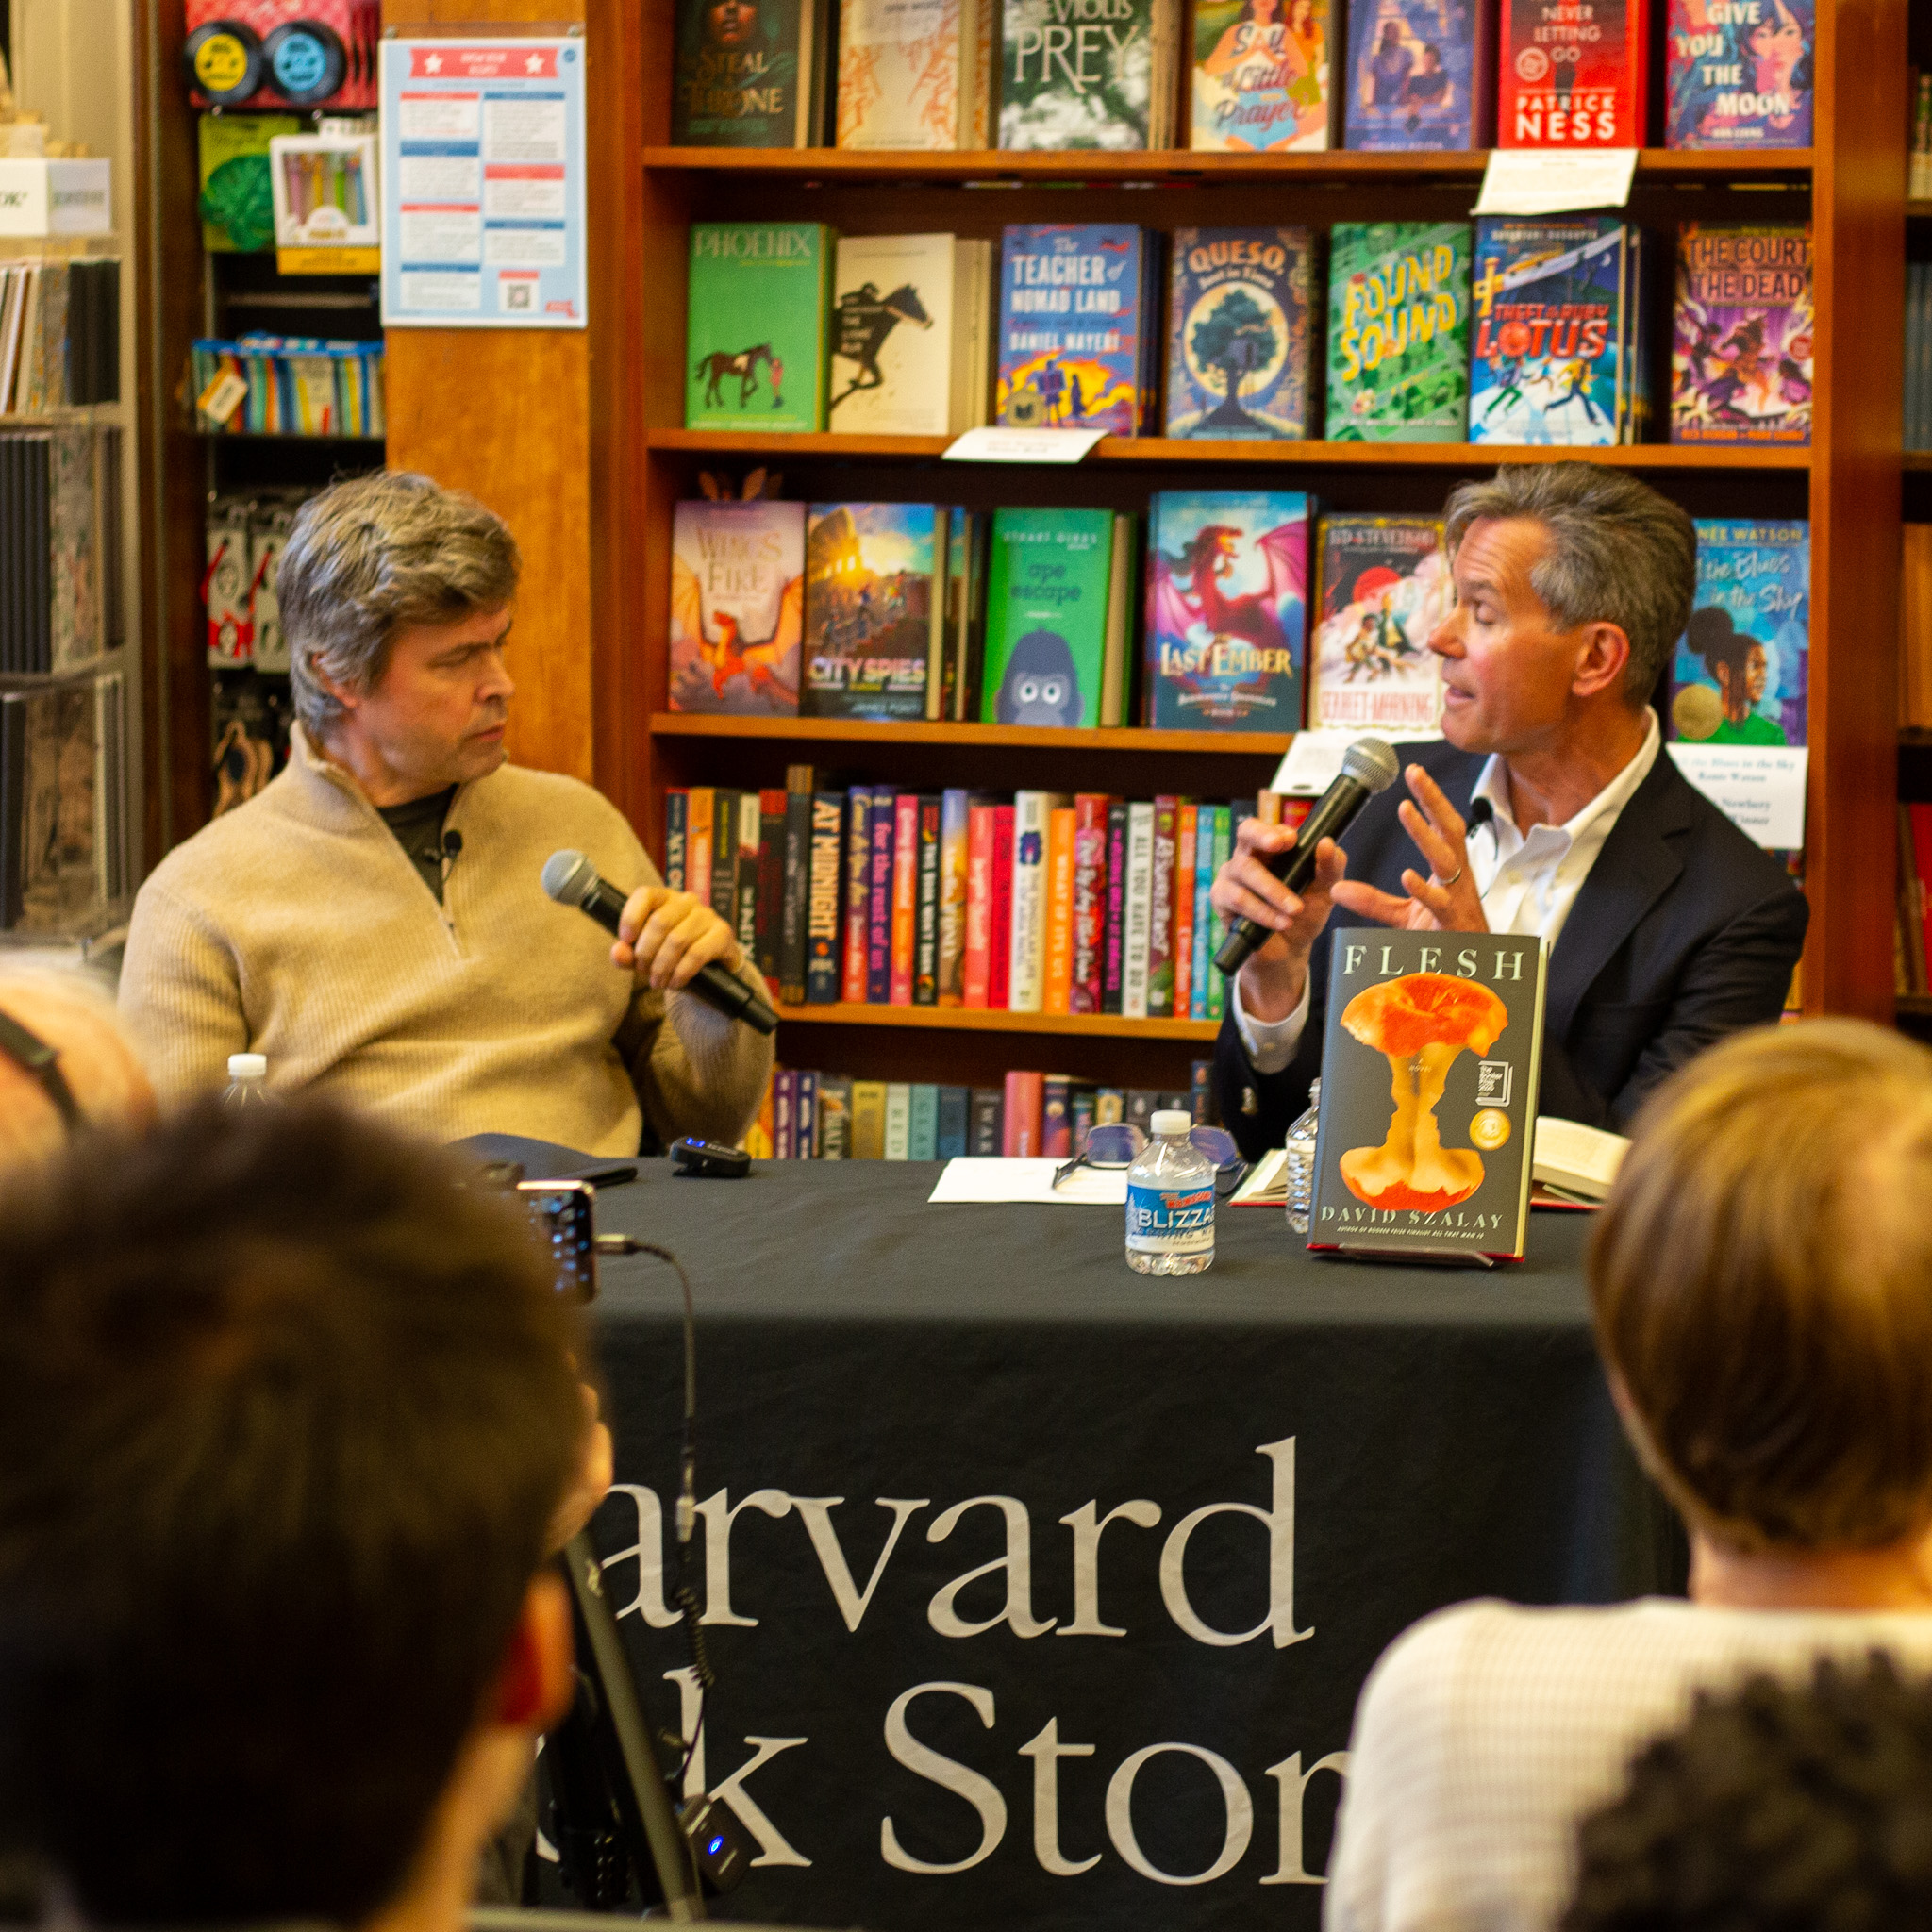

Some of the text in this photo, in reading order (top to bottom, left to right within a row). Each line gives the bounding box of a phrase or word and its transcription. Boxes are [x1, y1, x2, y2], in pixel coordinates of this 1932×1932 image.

[1542, 5, 1593, 21] NEVER
[1707, 2, 1761, 25] GIVE
[1534, 25, 1601, 43] LETTING
[1676, 34, 1724, 58] YOU
[1013, 25, 1140, 94] PREY
[1550, 46, 1581, 63] GO
[1703, 65, 1743, 85] THE
[1516, 95, 1615, 111] PATRICK
[1716, 93, 1790, 116] MOON
[1515, 112, 1616, 140] NESS
[1688, 238, 1807, 265] THE COURT
[1011, 255, 1106, 285] TEACHER
[1343, 244, 1457, 331] FOUND
[1695, 273, 1803, 299] THE DEAD
[1074, 289, 1121, 313] LAND
[1340, 293, 1461, 382] SOUND
[1475, 319, 1609, 358] LOTUS
[1697, 525, 1803, 541] NÉE WATSON
[1028, 563, 1067, 582] ape
[1009, 584, 1083, 607] escape
[874, 822, 891, 850] for
[808, 800, 841, 941] AT MIDNIGHT
[874, 854, 890, 885] the
[873, 887, 888, 923] rest
[1130, 836, 1148, 988] ALL YOU HAVE TO DO
[872, 925, 888, 946] of
[1342, 944, 1524, 981] FLESH
[978, 1106, 995, 1153] WAR
[1138, 1205, 1216, 1229] BLIZZA
[1321, 1206, 1503, 1229] DAVID SZALAY
[602, 1435, 1315, 1650] arvard
[880, 1681, 1357, 1888] Stor
